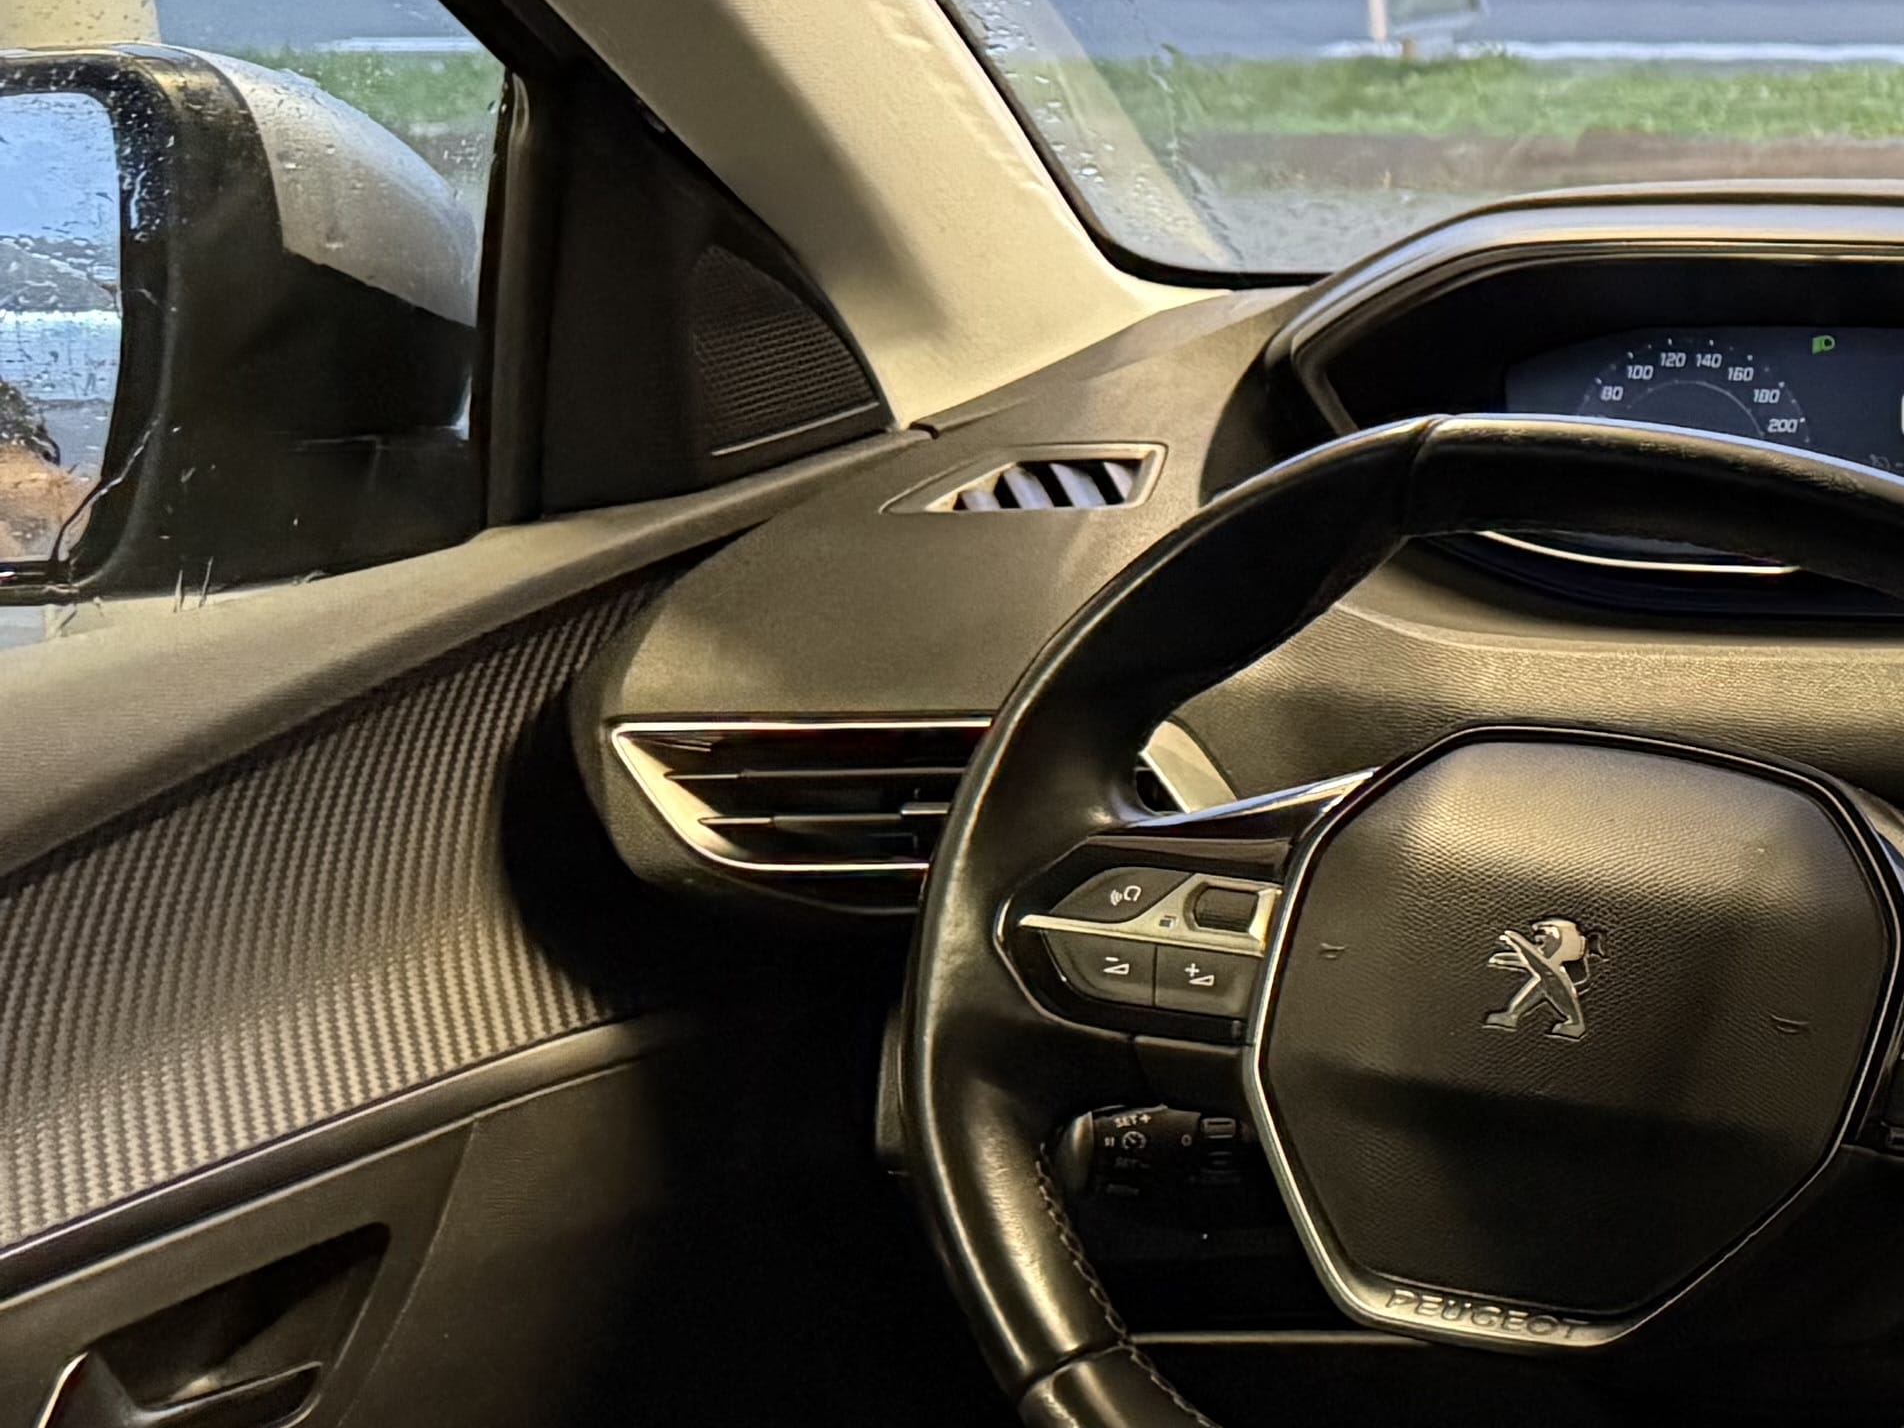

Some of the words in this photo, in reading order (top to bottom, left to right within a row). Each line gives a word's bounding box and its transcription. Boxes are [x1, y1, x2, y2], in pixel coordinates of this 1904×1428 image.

[1660, 352, 1687, 368] 120
[1695, 353, 1722, 368] 140
[1626, 365, 1654, 380] 100
[1727, 366, 1755, 382] 160
[1600, 385, 1625, 402] 80
[1752, 388, 1781, 404] 180
[1767, 418, 1799, 434] 200
[1385, 1288, 1591, 1339] PEUGEOT
